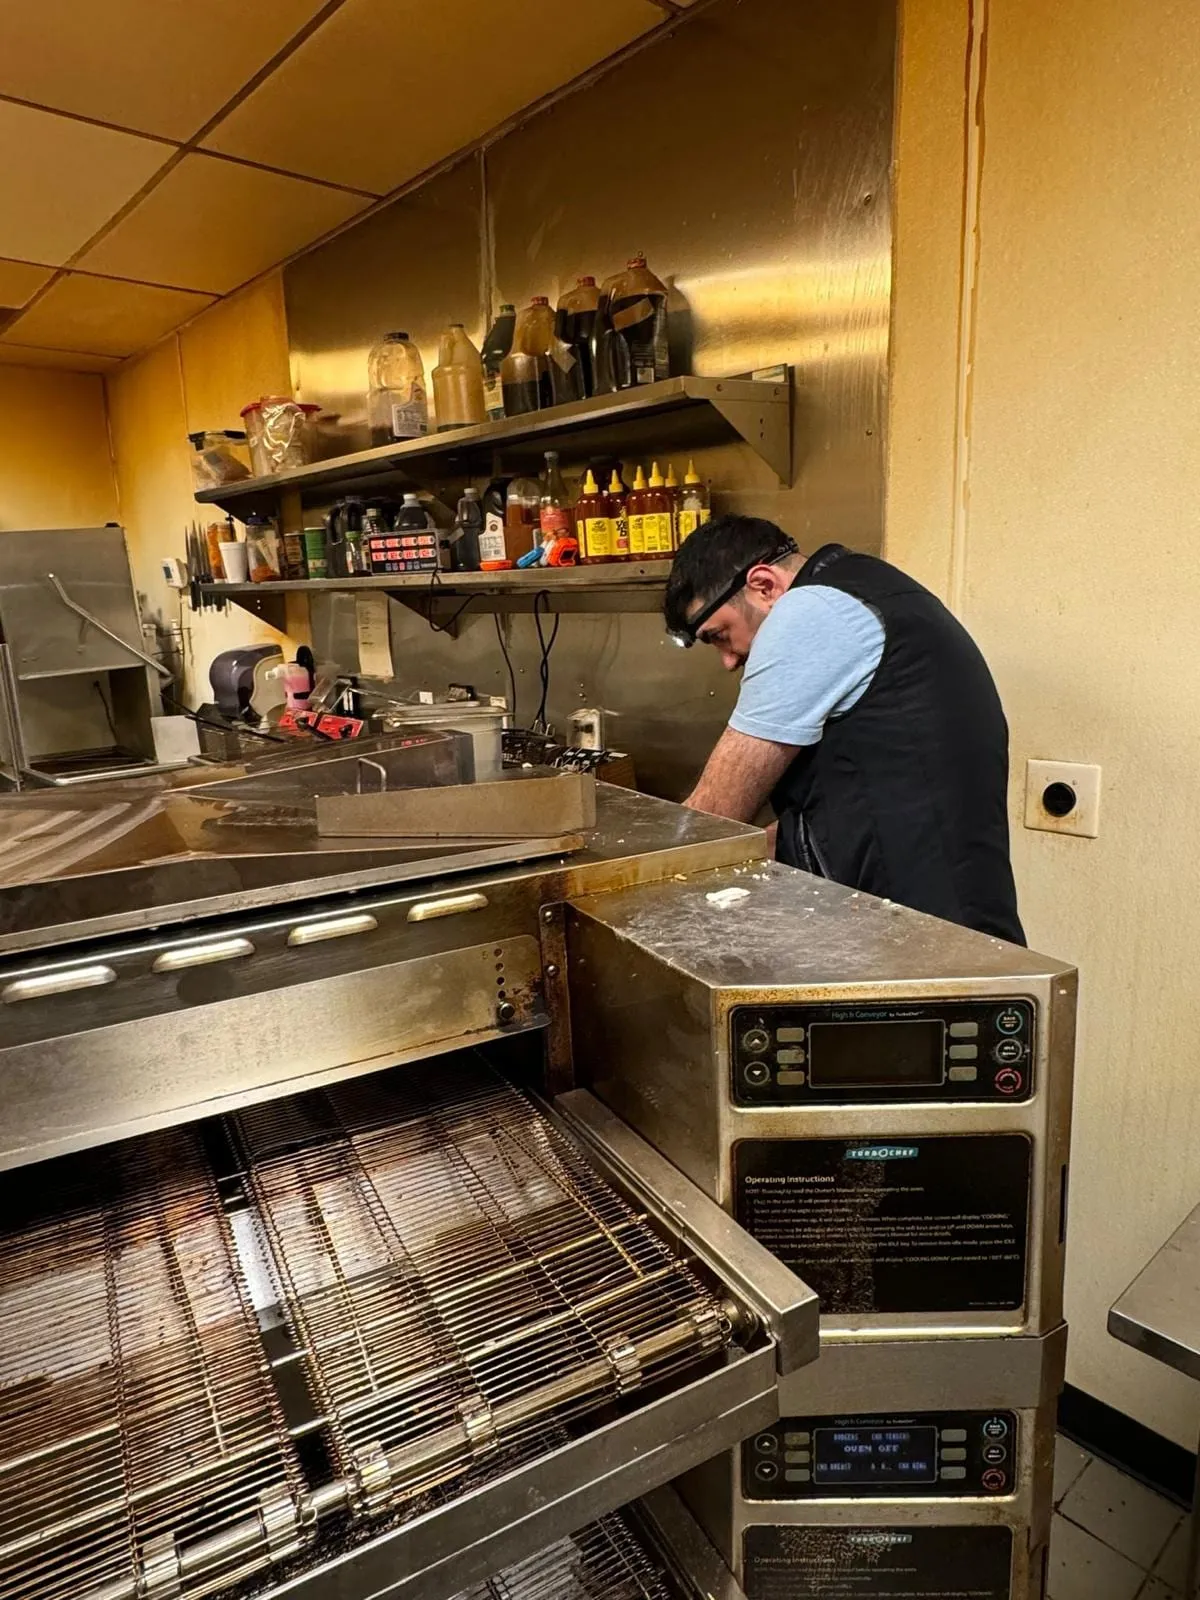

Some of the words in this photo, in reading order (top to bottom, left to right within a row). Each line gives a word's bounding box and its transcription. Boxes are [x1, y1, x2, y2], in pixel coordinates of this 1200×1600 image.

[855, 1010, 887, 1020] Conveyor
[745, 1176, 786, 1185] Operating
[787, 1175, 835, 1183] Instructions
[843, 1444, 872, 1453] OVEN
[878, 1444, 900, 1453] OFF
